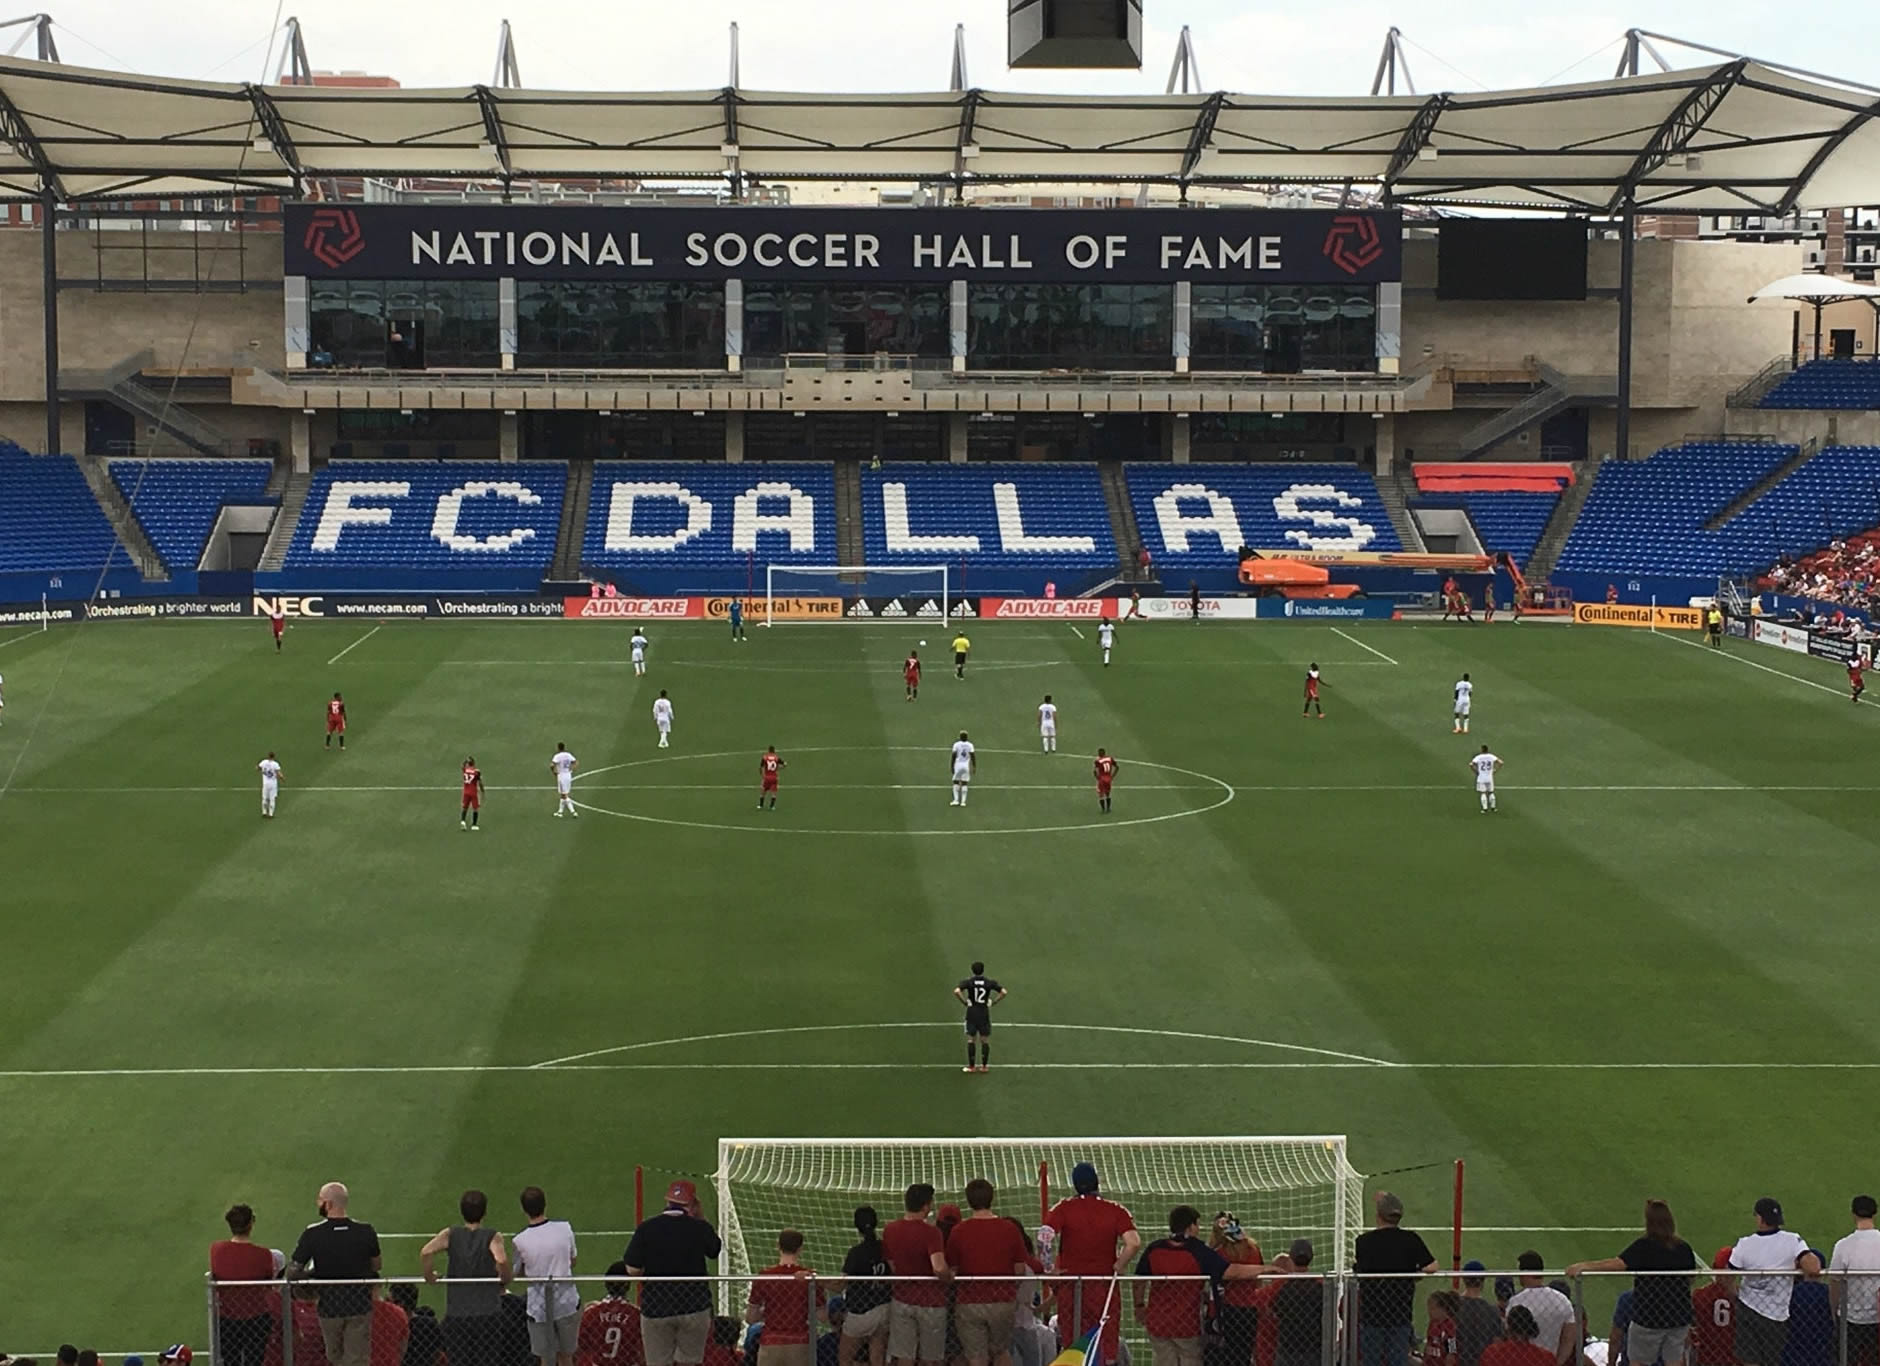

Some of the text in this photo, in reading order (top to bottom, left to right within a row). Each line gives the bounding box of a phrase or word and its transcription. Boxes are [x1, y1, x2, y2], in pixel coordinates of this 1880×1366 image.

[411, 231, 1283, 270] NATIONAL SOCCER HALL OF FAME
[311, 482, 1376, 553] FC DALLAS
[210, 602, 241, 613] world
[253, 597, 324, 616] NEC
[337, 603, 428, 613] www.necam.com
[581, 599, 689, 617] ADVOCARE
[806, 602, 840, 613] TIRE
[996, 599, 1103, 617] ADVOCARE
[1578, 604, 1699, 625] Continental TIRE
[974, 987, 987, 1004] 12
[1713, 1298, 1731, 1327] 6
[602, 1327, 622, 1358] 9
